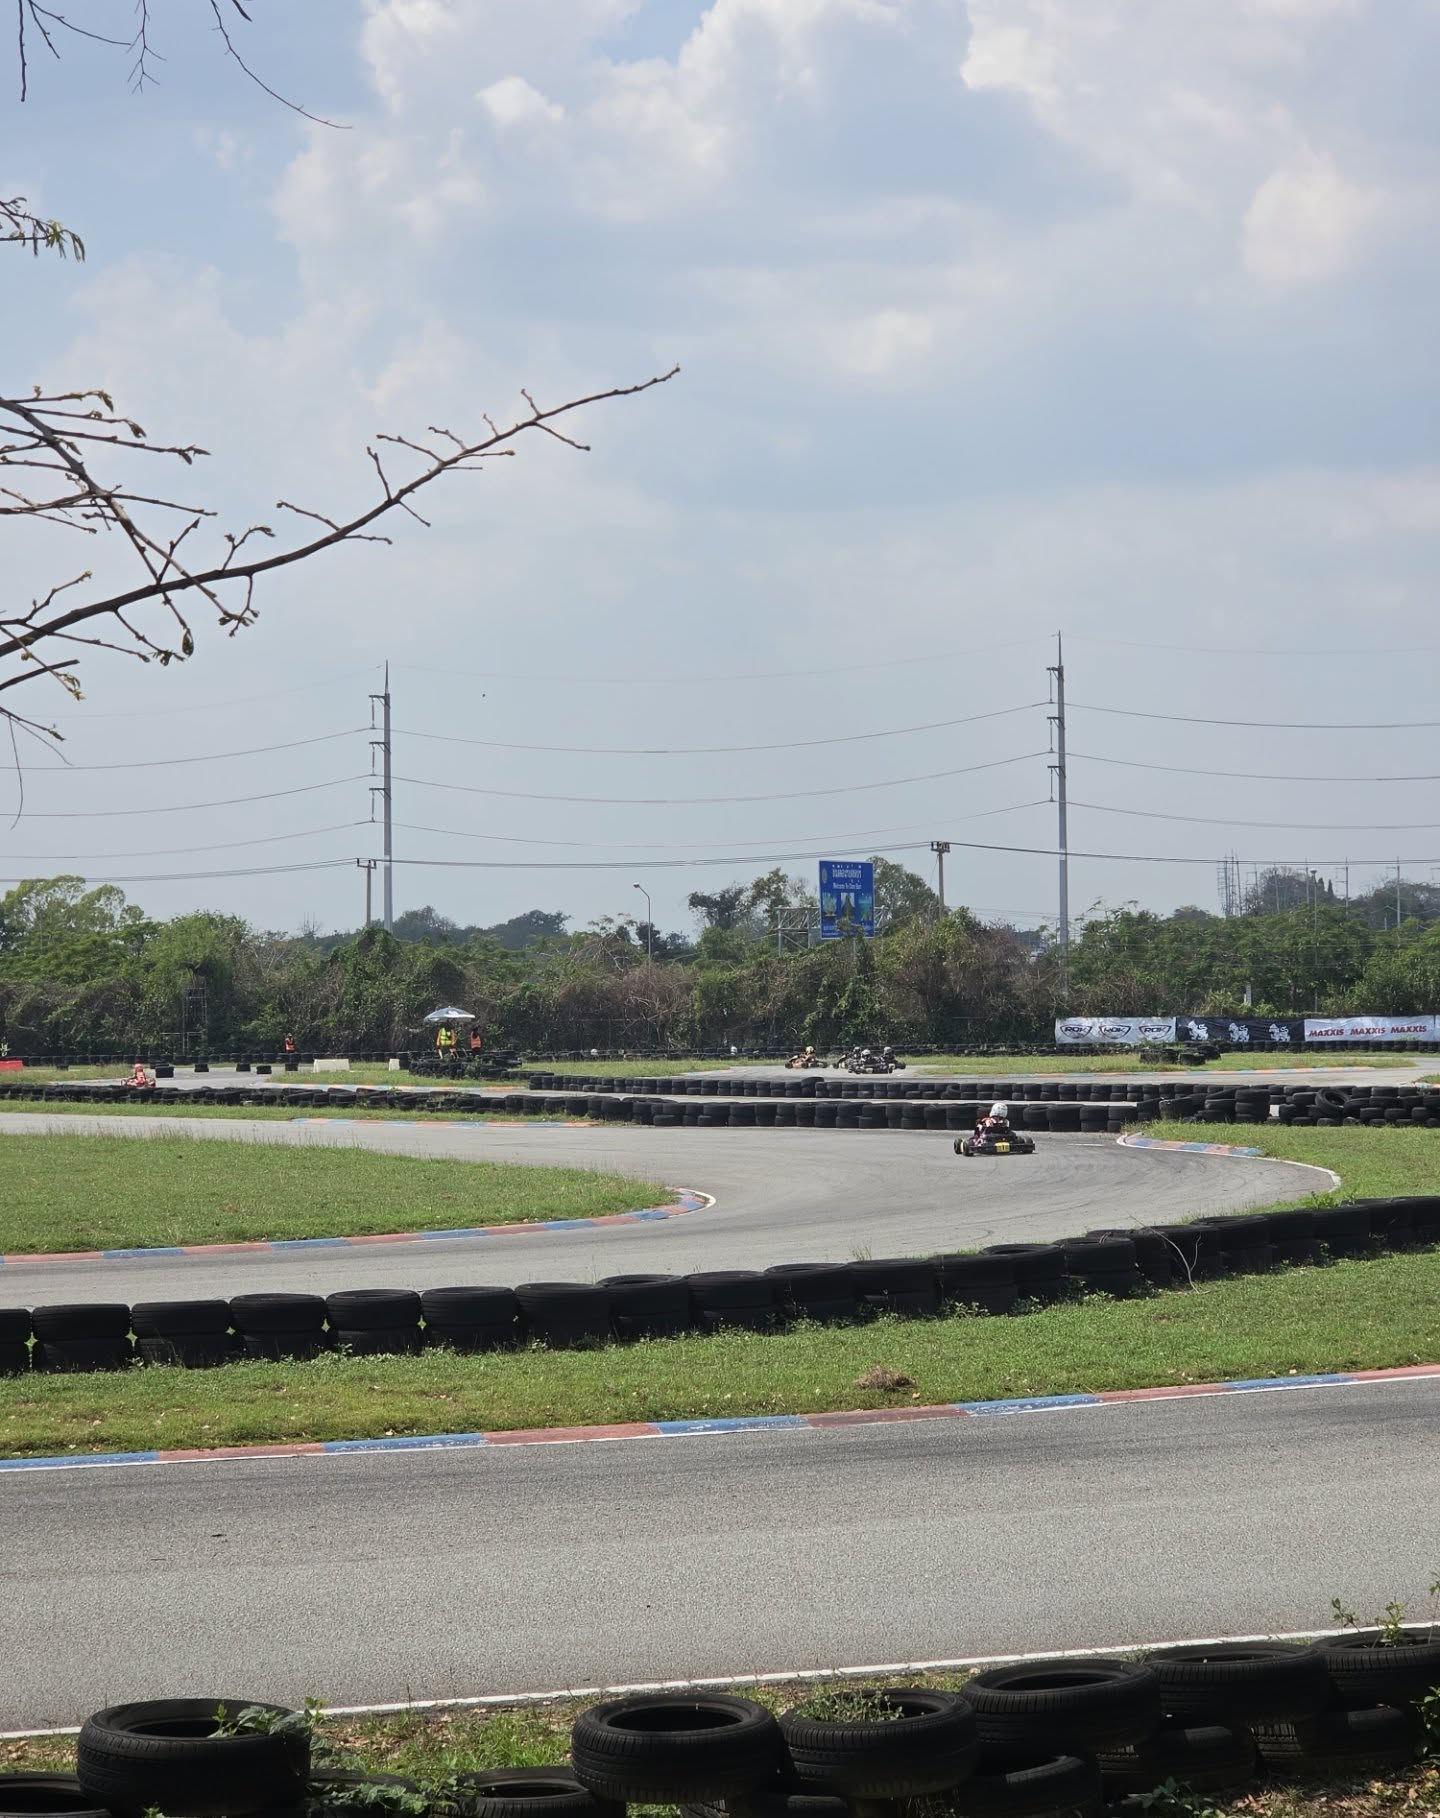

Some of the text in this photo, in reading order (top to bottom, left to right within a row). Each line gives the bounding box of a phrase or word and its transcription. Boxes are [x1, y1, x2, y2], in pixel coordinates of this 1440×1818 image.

[1309, 1025, 1427, 1037] MAXXIS MAXXIS MAXXIS
